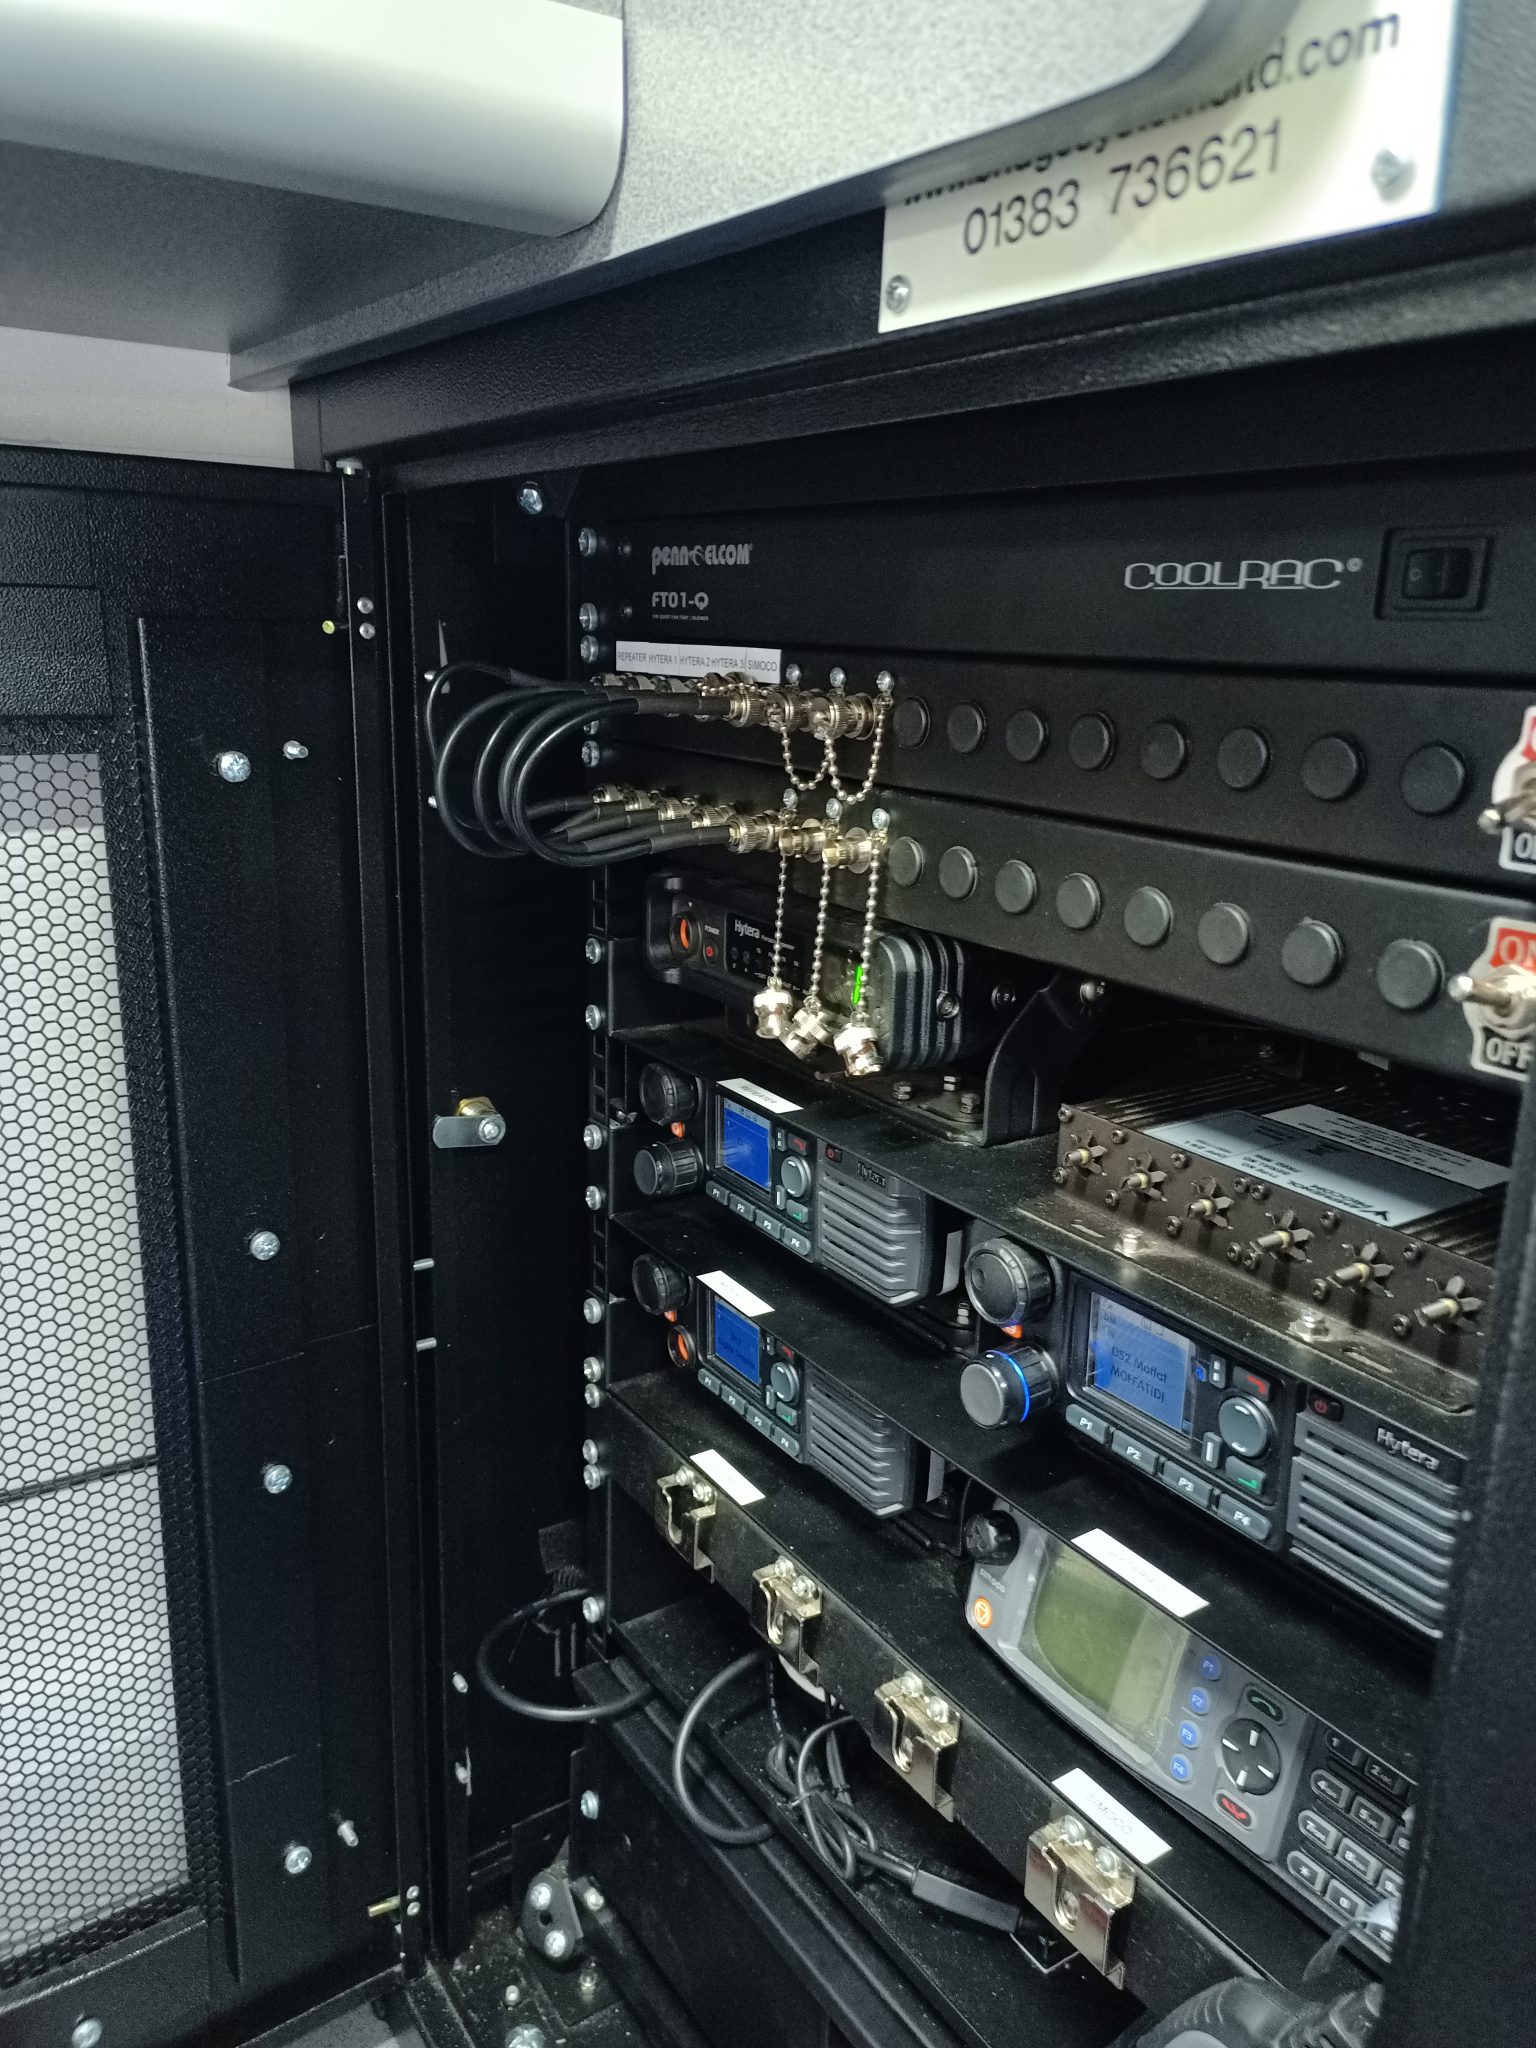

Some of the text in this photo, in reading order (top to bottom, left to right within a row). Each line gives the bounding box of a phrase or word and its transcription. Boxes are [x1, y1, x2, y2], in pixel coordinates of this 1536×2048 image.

[963, 178, 1080, 256] 01383
[1107, 117, 1282, 216] 736621
[652, 591, 709, 611] FT01-Q
[616, 651, 647, 663] REPEATER
[649, 653, 673, 665] HYTERA
[679, 655, 706, 667] HYTERA
[705, 656, 711, 667] 2
[712, 658, 738, 669] HYTERA
[738, 658, 744, 669] 3
[748, 659, 778, 672] SIMOCO
[734, 919, 760, 939] Hytera
[1079, 1416, 1094, 1431] P1
[1126, 1446, 1142, 1462] P2
[1376, 1426, 1440, 1471] Hytera
[1177, 1476, 1194, 1492] P3
[1233, 1510, 1251, 1527] P4
[1202, 1660, 1215, 1673] F1
[1191, 1694, 1204, 1708] F2
[1180, 1728, 1193, 1742] F3
[1172, 1762, 1185, 1776] F4
